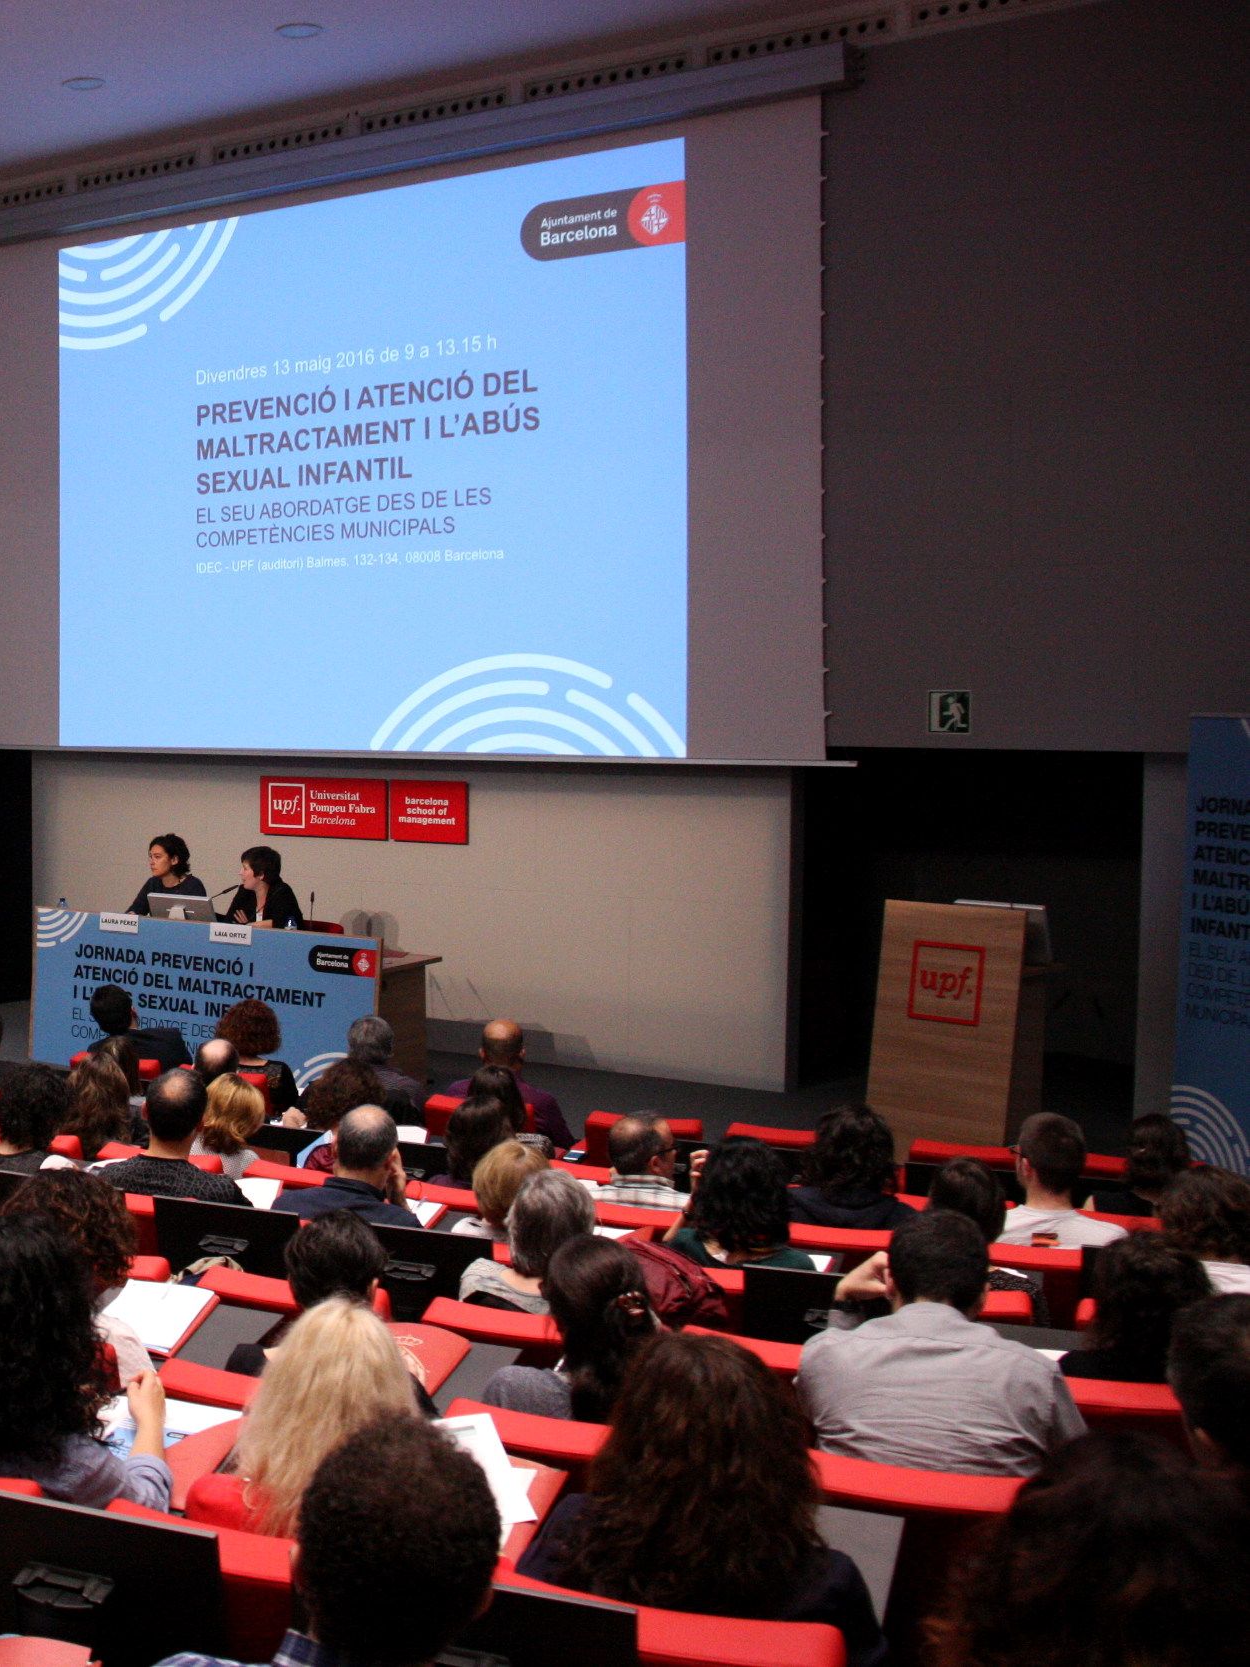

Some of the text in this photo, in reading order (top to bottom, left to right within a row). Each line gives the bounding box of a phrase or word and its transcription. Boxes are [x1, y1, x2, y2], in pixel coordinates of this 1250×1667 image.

[541, 208, 617, 230] Ajuntament de
[540, 223, 617, 246] Barcelona
[196, 334, 497, 386] Divendres 13 maig 2016 de 9 a 13.15 h
[197, 369, 538, 427] PREVENCIÓ I ATENCIÓ DEL
[197, 402, 541, 461] MALTRACTAMENT I L'ABÚS
[197, 456, 413, 495] SEXUAL INFANTIL
[197, 487, 492, 524] EL SEU ABORDATGE DES DE LES
[197, 516, 456, 549] COMPETÈNCIES MUNICIPALS
[196, 561, 222, 574] IDEC
[232, 559, 255, 572] UPF
[258, 556, 304, 572] (auditori)
[406, 549, 441, 563] 08008
[445, 547, 504, 562] Barcelona
[273, 795, 301, 815] upf.
[310, 789, 360, 801] Universitat
[405, 797, 449, 806] barcelona
[310, 802, 376, 815] Pompeu Fabra
[310, 815, 356, 826] Barcelona
[399, 815, 456, 826] management
[407, 806, 447, 816] school of
[75, 943, 253, 978] JORNADA PREVENCIÓ I
[317, 959, 348, 968] Barcelona
[73, 966, 326, 1008] ATENCIÓ DEL MALTRACTAMENT
[920, 966, 973, 1000] upf.
[73, 1007, 85, 1020] EL
[74, 987, 77, 998] I
[138, 993, 198, 1014] SEXUAL
[205, 1002, 230, 1017] INF
